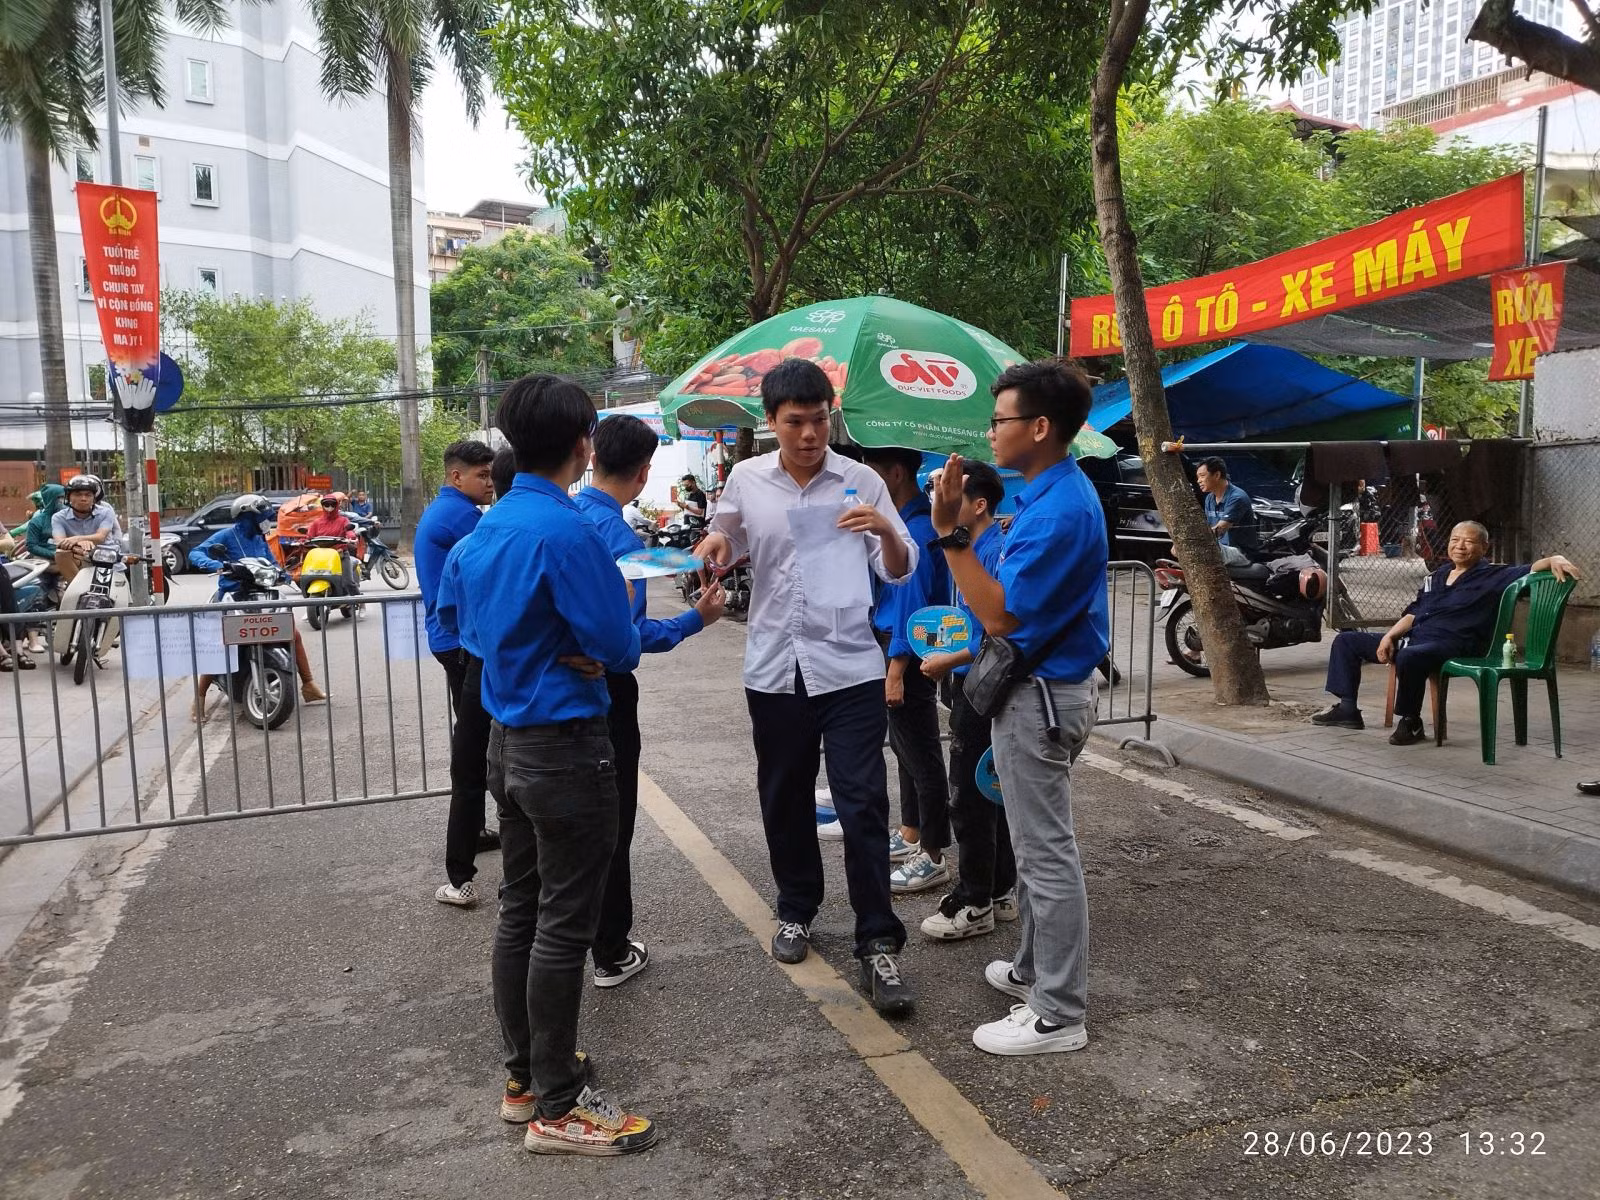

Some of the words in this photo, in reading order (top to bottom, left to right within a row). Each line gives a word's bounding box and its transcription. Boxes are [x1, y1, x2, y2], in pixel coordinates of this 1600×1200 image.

[1162, 295, 1184, 342] Ô
[1195, 282, 1239, 337] TÔ
[1280, 261, 1337, 318] XE
[1352, 216, 1472, 298] MÁY
[130, 283, 145, 295] TAY
[1496, 271, 1554, 327] RỬA
[790, 326, 837, 334] DAESANG
[113, 333, 129, 346] MA
[1504, 336, 1540, 377] XE
[937, 388, 967, 397] FOODS
[865, 420, 891, 428] CÔNG
[892, 420, 903, 428] TY
[941, 426, 978, 437] DAESANG
[243, 617, 273, 625] POLICE
[239, 626, 280, 639] STOP
